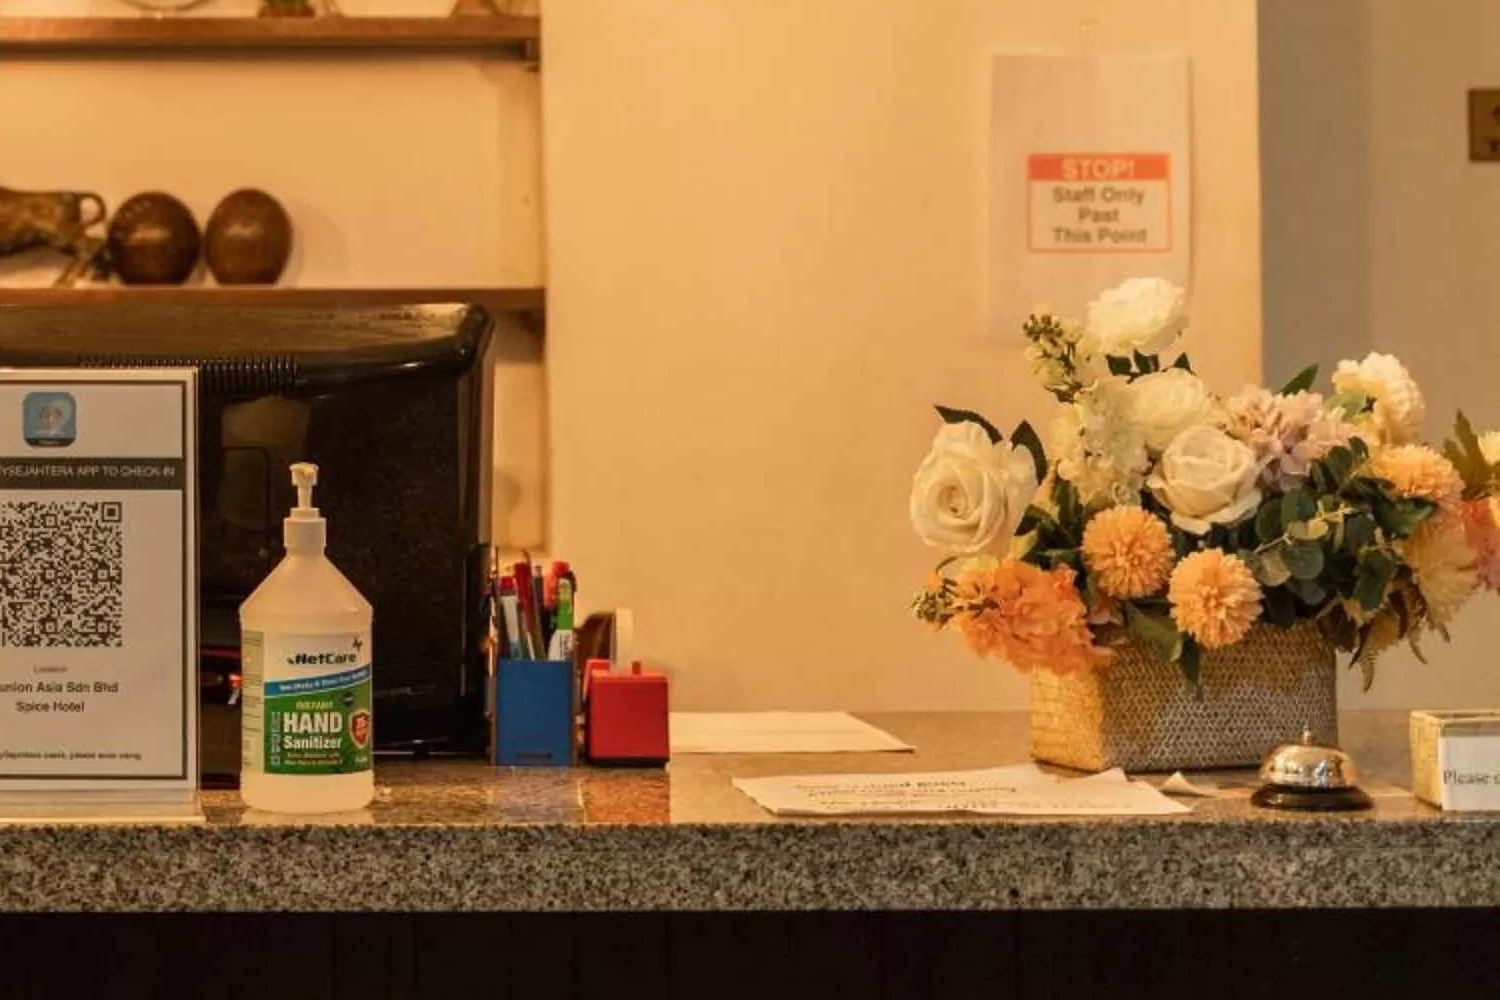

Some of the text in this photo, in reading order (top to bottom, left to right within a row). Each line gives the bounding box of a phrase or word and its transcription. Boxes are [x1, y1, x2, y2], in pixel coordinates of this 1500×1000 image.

[1062, 157, 1135, 180] STOP!
[1052, 187, 1145, 206] Staff Only
[1078, 206, 1120, 223] Past
[1052, 227, 1147, 243] This Point
[76, 465, 99, 477] APP
[102, 465, 118, 477] TO
[295, 652, 357, 665] NetCare
[36, 681, 63, 693] Asia
[67, 681, 91, 693] Sdn
[93, 681, 119, 693] Bhd
[16, 701, 85, 714] Spice Hotel
[283, 711, 343, 733] HAND
[283, 735, 343, 749] Sanitizer
